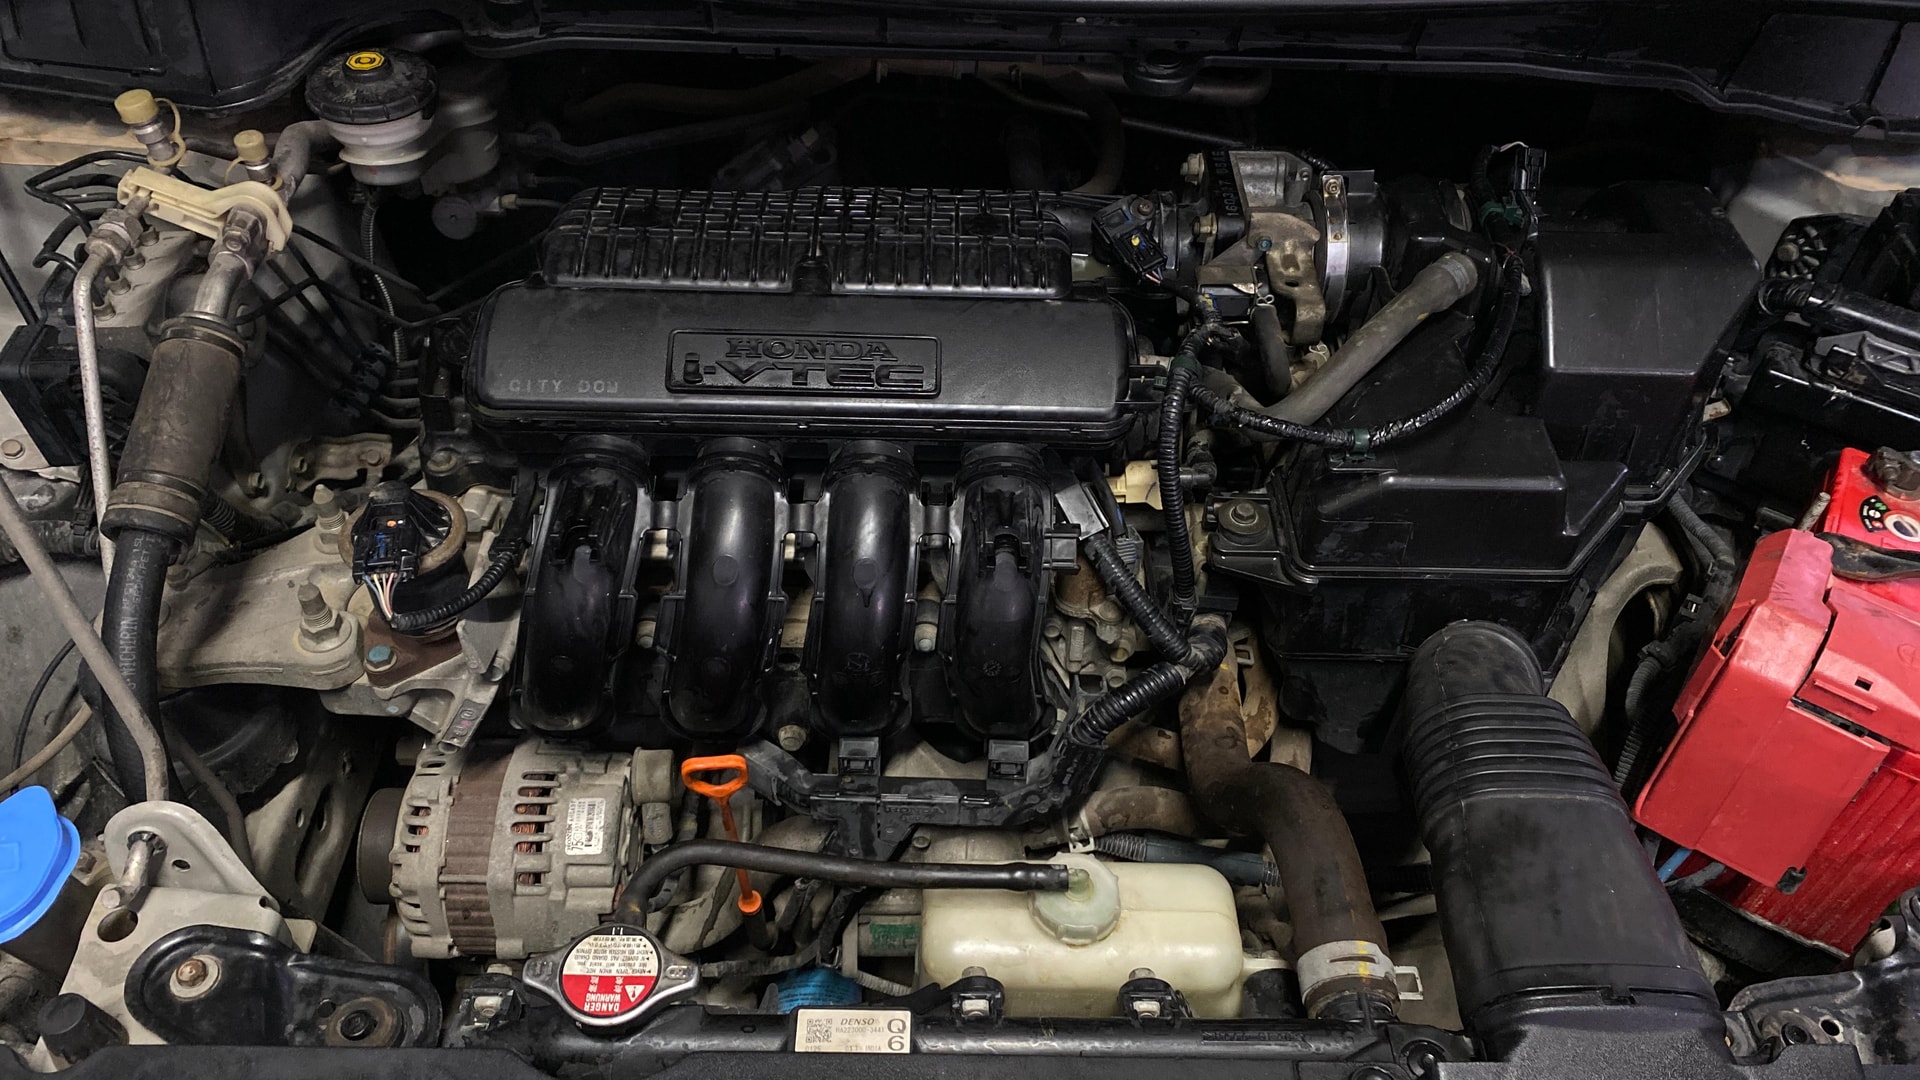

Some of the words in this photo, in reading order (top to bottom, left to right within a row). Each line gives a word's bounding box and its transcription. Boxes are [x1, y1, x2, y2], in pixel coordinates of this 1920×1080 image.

[726, 338, 898, 361] HONDA
[682, 352, 925, 389] i-VTEC
[508, 379, 563, 393] CITY
[119, 616, 138, 675] NICHIRIN
[585, 993, 621, 1002] WARNUNG
[583, 1002, 620, 1012] DANGER
[840, 1018, 875, 1026] DENSO
[887, 1018, 907, 1034] Q
[887, 1035, 905, 1051] 6
